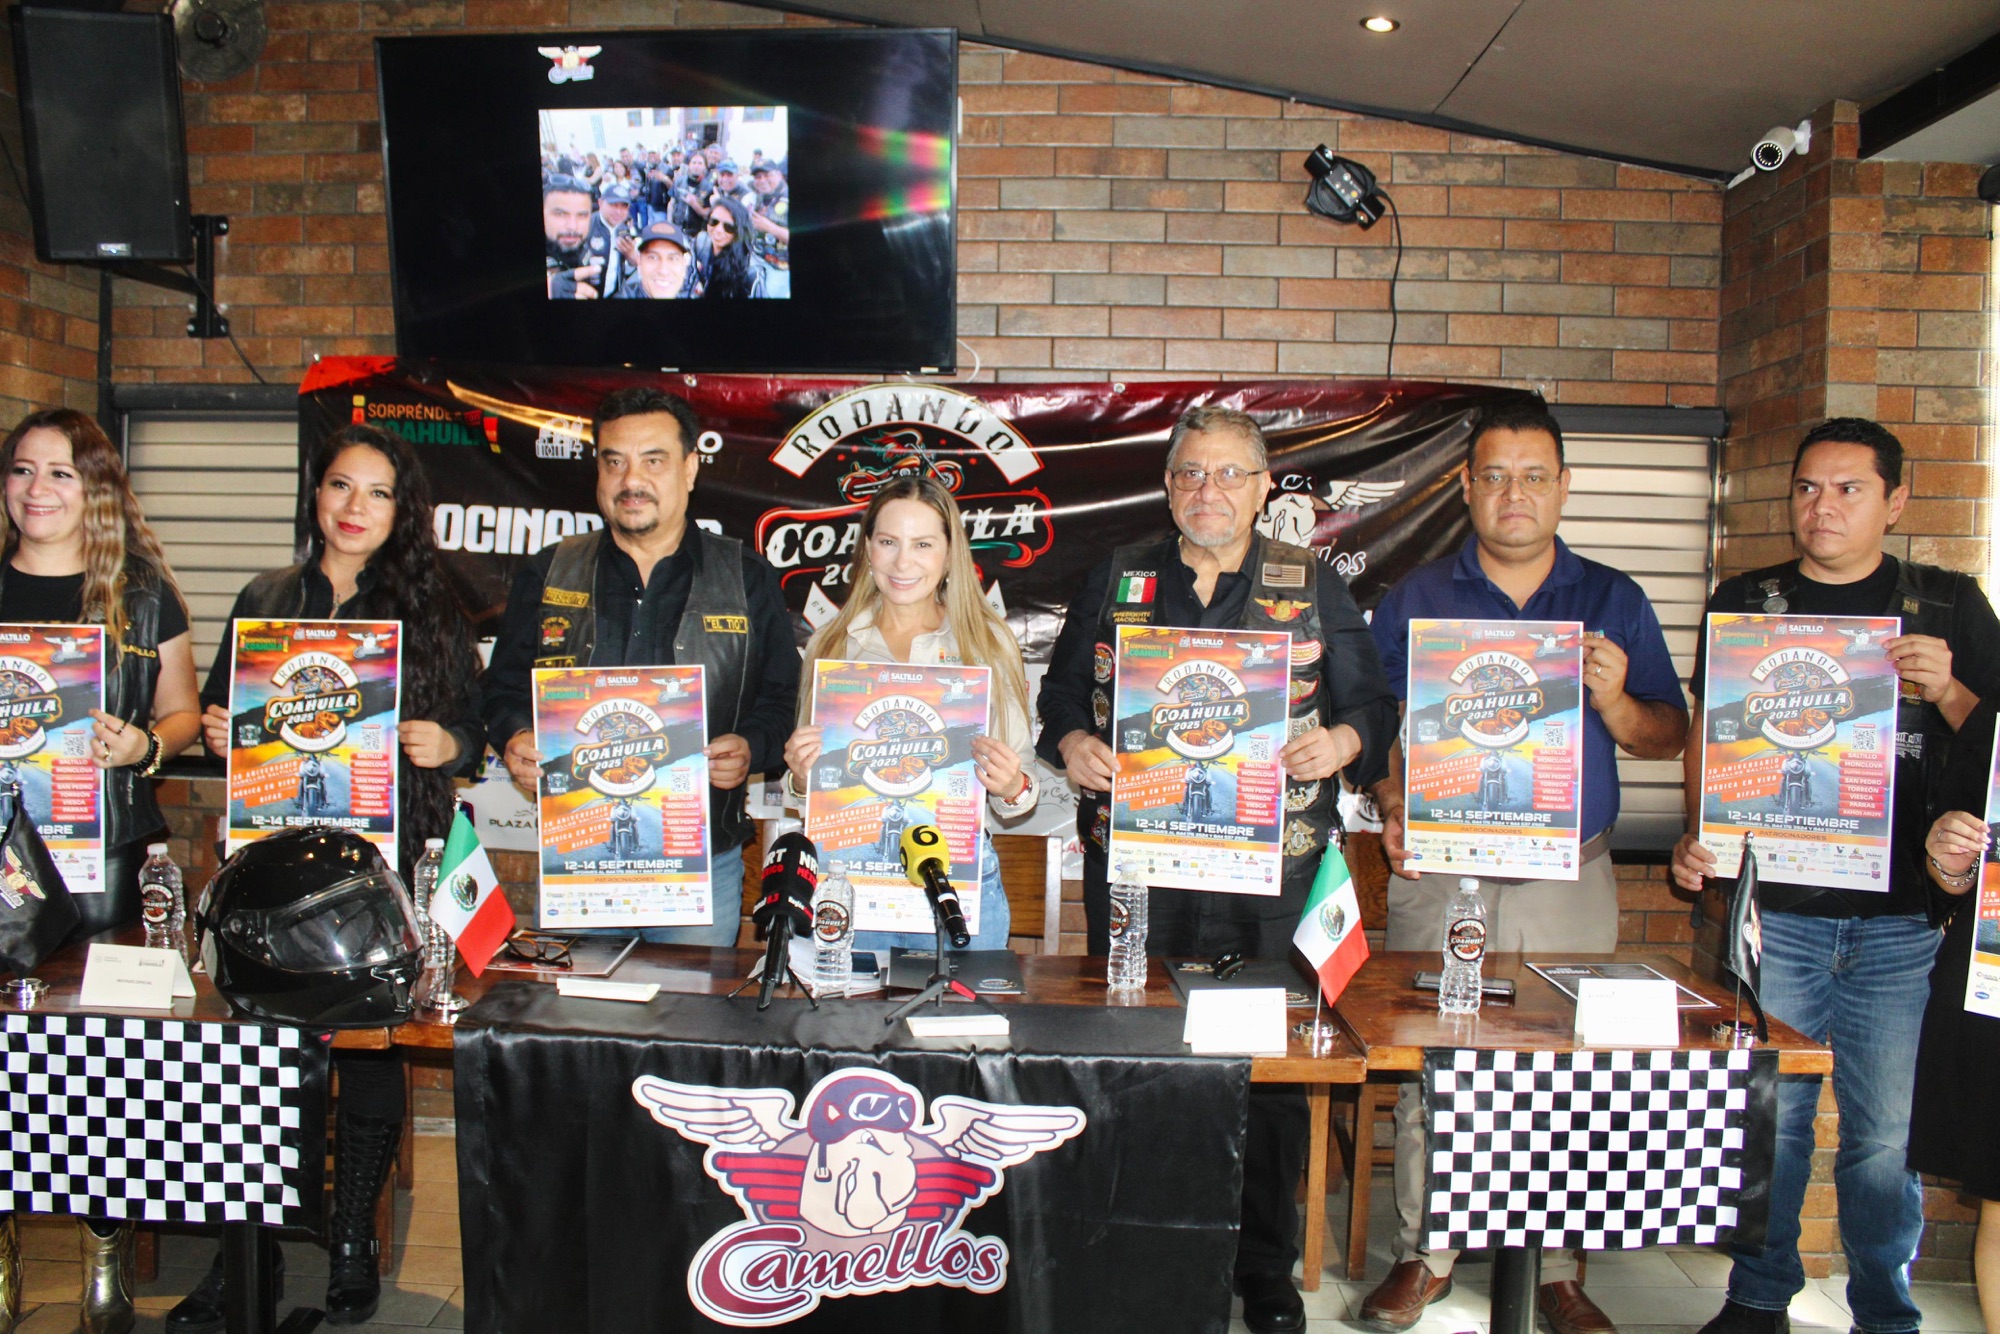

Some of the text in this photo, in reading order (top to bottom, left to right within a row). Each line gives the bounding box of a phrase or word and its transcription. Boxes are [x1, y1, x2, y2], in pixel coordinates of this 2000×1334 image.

[791, 394, 1014, 459] RODANDO
[1789, 624, 1823, 632] SALTILLO
[1192, 638, 1223, 646] SALTILLO
[1457, 655, 1529, 677] RODANDO
[1758, 651, 1839, 674] RODANDO
[891, 673, 922, 681] SALTILLO
[1164, 664, 1237, 686] RODANDO
[1450, 693, 1537, 714] COAHUILA
[1750, 692, 1846, 713] COAHUILA
[862, 699, 936, 722] RODANDO
[1156, 704, 1244, 724] COAHUILA
[1467, 711, 1493, 720] 2025
[1769, 710, 1798, 720] 2025
[1173, 721, 1200, 730] 2025
[576, 739, 663, 765] COAHUILA
[852, 741, 943, 761] COAHUILA
[870, 758, 898, 767] 2025
[1722, 758, 1779, 772] ANIVERSARIO
[1757, 775, 1776, 783] VIVO
[1163, 784, 1180, 792] VIVO
[1737, 790, 1760, 798] RIFAS
[252, 816, 369, 828] 12-14 SEPTIEMBRE
[1431, 809, 1551, 822] 12-14 SEPTIEMBRE
[1728, 811, 1859, 829] 12-14 SEPTIEMBRE
[489, 819, 532, 828] PLAZA
[1136, 821, 1254, 836] 12-14 SEPTIEMBRE
[912, 825, 939, 846] 6
[565, 860, 682, 870] 12-14 SEPTIEMBRE
[701, 1222, 1000, 1315] Camellos
